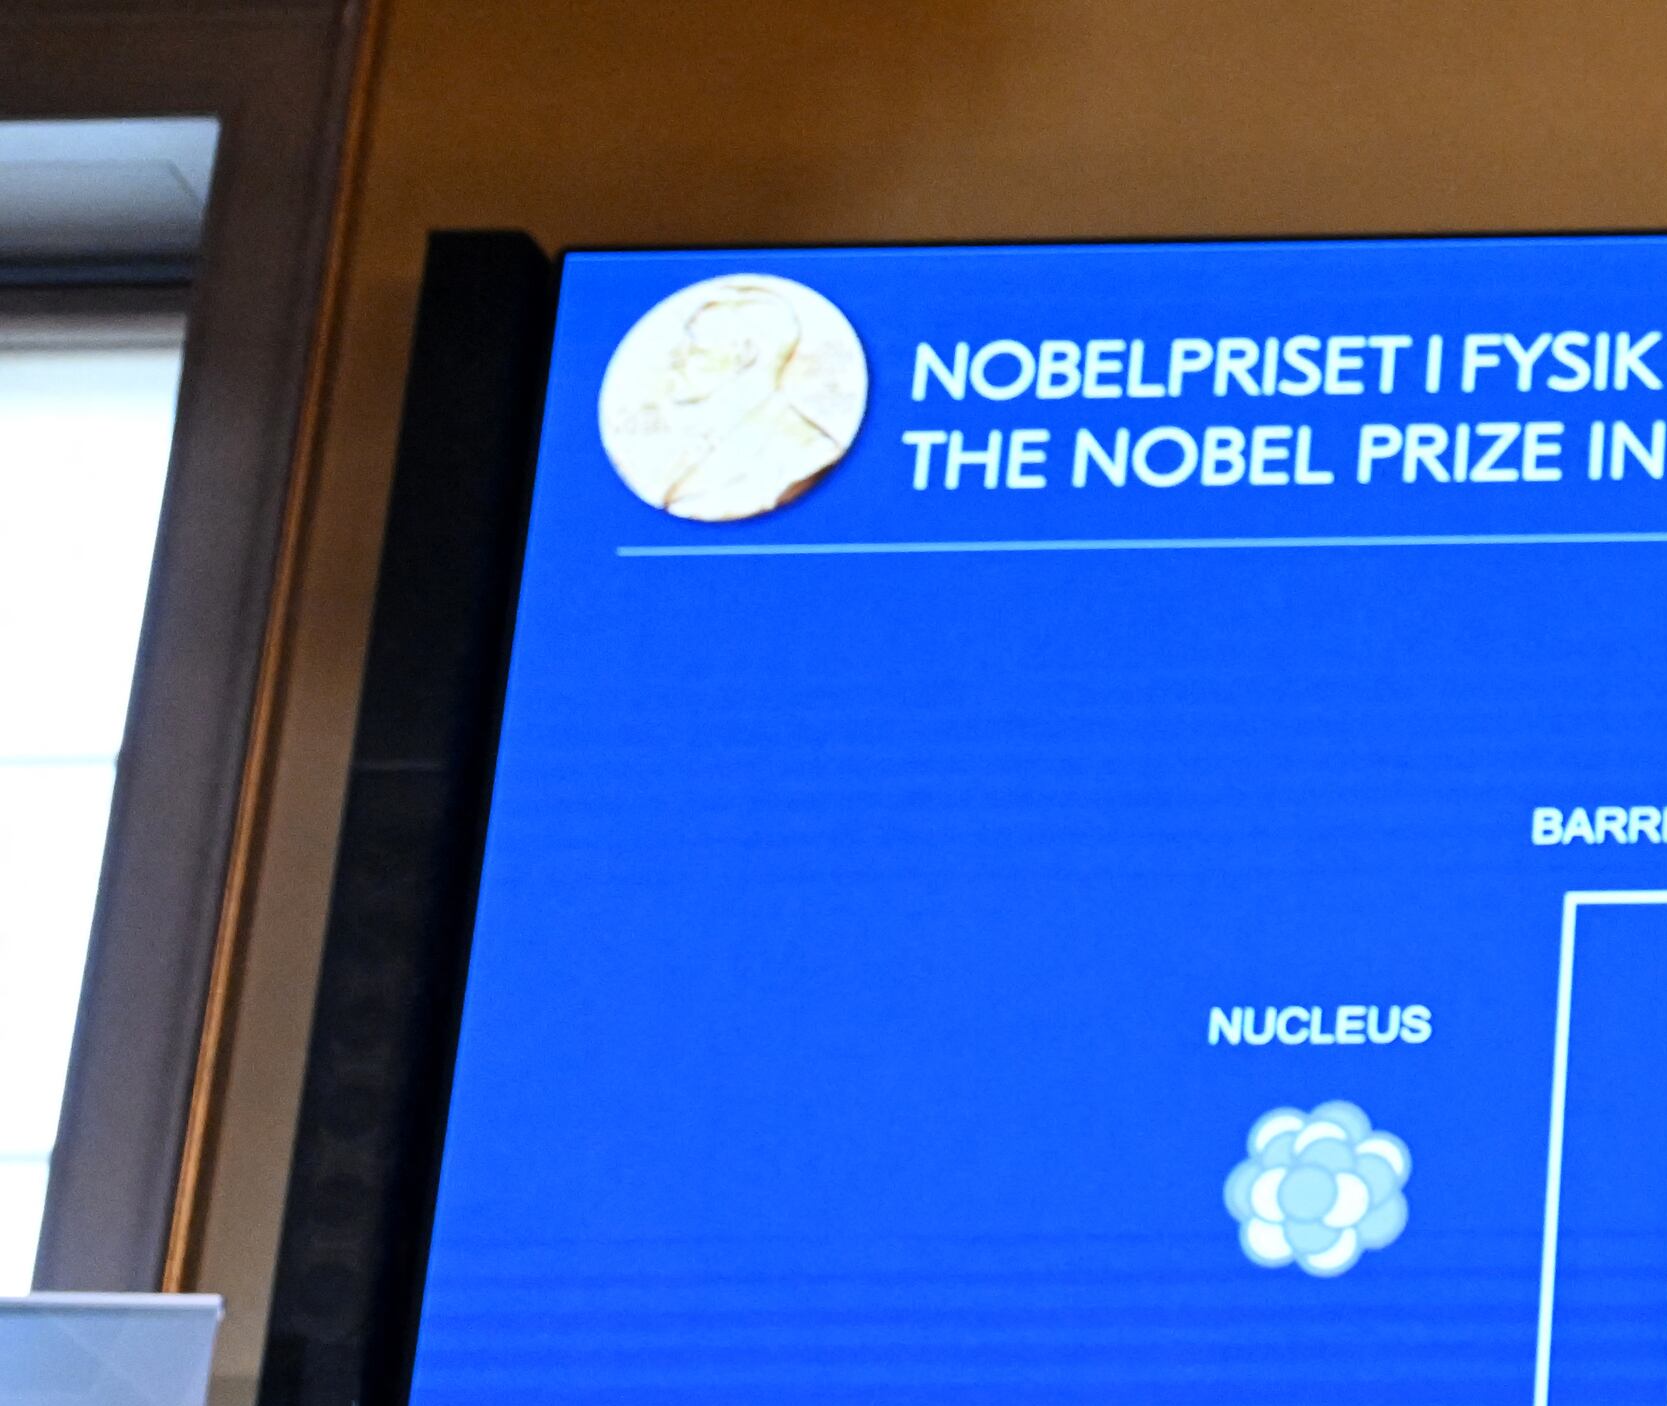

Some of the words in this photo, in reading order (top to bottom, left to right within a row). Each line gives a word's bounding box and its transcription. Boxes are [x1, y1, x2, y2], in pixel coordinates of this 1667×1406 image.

[912, 334, 1413, 402] NOBELPRISET
[1425, 333, 1443, 395] I
[1461, 330, 1663, 394] FYSIK
[902, 427, 1050, 492] THE
[1072, 424, 1335, 489] NOBEL
[1357, 420, 1565, 484] PRIZE
[1588, 419, 1666, 481] IN
[1207, 1004, 1433, 1046] NUCLEUS
